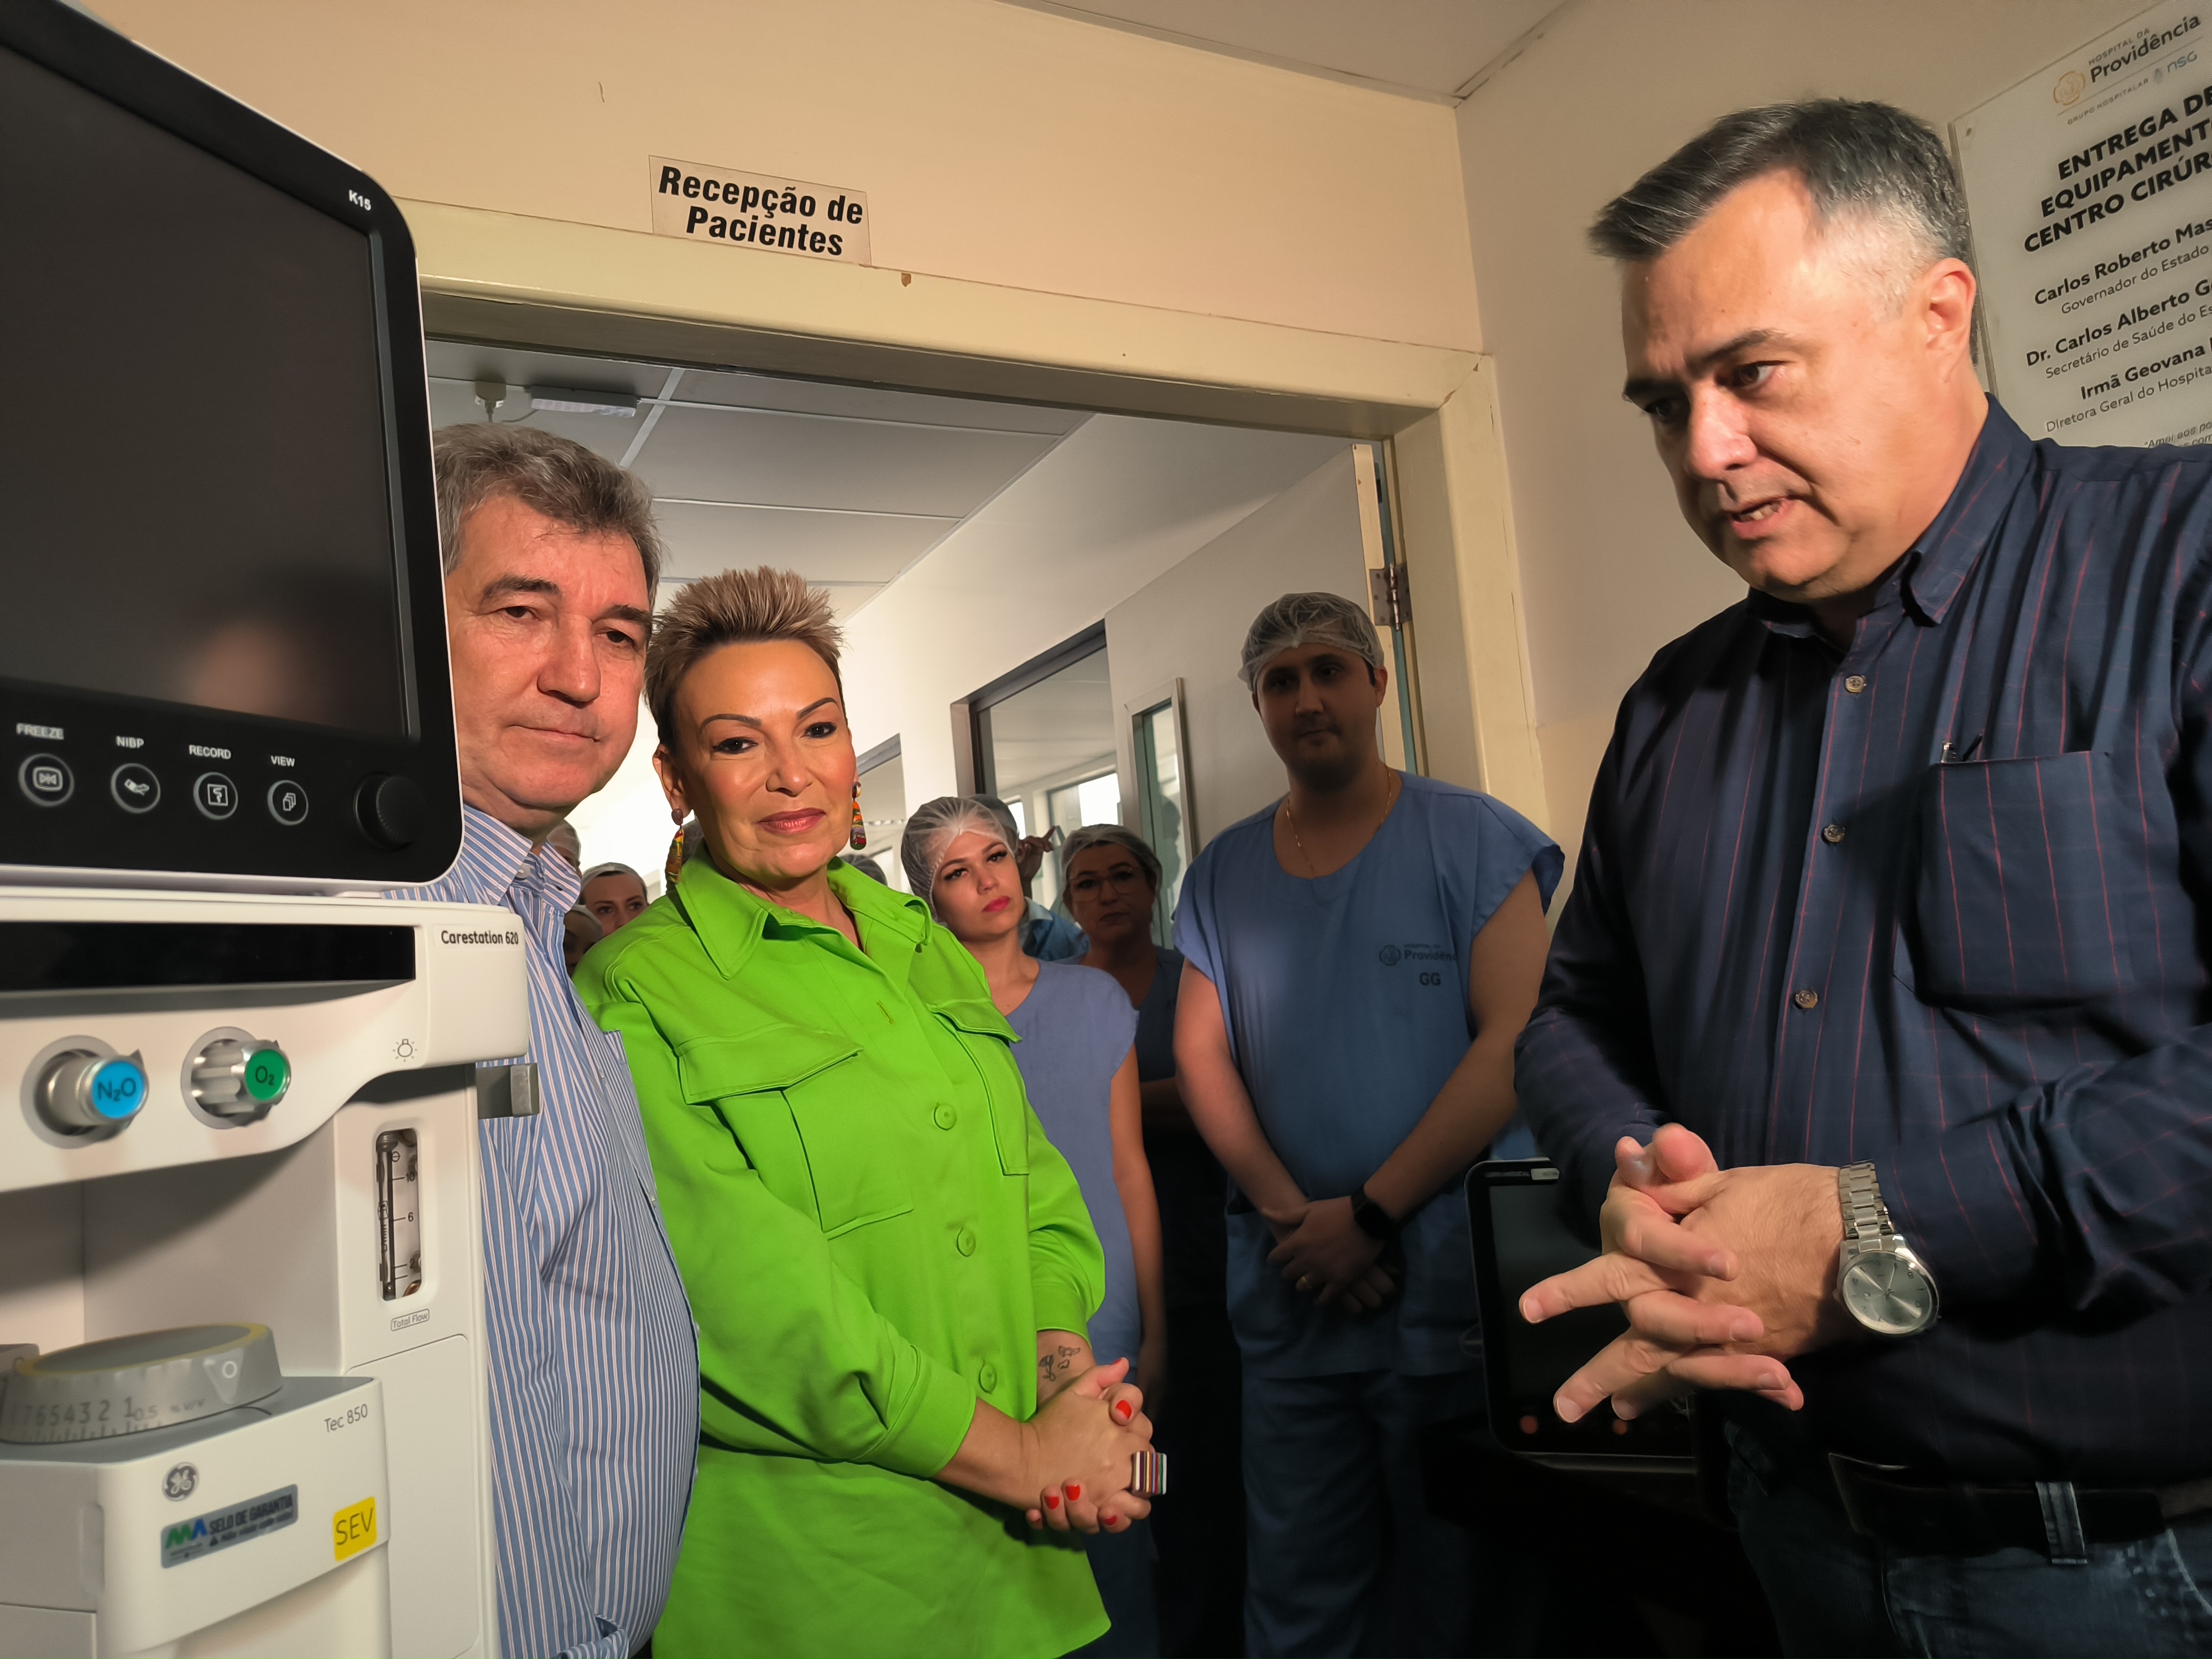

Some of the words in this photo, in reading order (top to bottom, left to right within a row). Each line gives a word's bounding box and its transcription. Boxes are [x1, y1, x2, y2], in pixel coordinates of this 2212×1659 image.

[2089, 38, 2133, 66] HOSPITAL
[2137, 28, 2150, 39] DA
[2090, 15, 2201, 83] Providência
[2067, 106, 2095, 125] GRUPO
[2097, 78, 2149, 109] HOSPITALAR
[2058, 108, 2178, 180] ENTREGA
[2183, 86, 2212, 117] DE
[2041, 118, 2212, 217] EQUIPAMENT
[349, 190, 371, 211] K15
[659, 165, 816, 218] Recepção
[827, 195, 863, 224] de
[2024, 194, 2124, 252] CENTRO
[2131, 152, 2212, 201] CIRÚR
[686, 206, 843, 255] Pacientes
[2035, 273, 2090, 304] Carlos
[2094, 239, 2171, 279] Roberto
[2175, 219, 2212, 244] Mas
[2061, 276, 2137, 314] Governador
[2141, 268, 2158, 280] do
[2161, 245, 2209, 272] Estado
[2026, 350, 2051, 366] Dr.
[2056, 324, 2112, 353] Carlos
[2117, 291, 2190, 330] Alberto
[2195, 279, 2212, 296] G
[2046, 347, 2109, 379] Secretário
[2112, 340, 2129, 352] de
[2132, 321, 2174, 345] Saúde
[2178, 312, 2195, 326] do
[2080, 374, 2121, 400] Irmã
[2125, 345, 2205, 382] Geovana
[2046, 408, 2096, 432] Diretora
[2100, 391, 2134, 412] Geral
[2137, 386, 2154, 399] do
[16, 722, 64, 740] FREEZE
[116, 736, 144, 748] NIBP
[189, 744, 231, 759] RECORD
[270, 755, 295, 767] VIEW
[441, 930, 503, 944] Carestation
[505, 931, 519, 945] 620
[1419, 972, 1441, 985] GG
[405, 1171, 415, 1182] 10
[408, 1212, 414, 1222] 6
[393, 1316, 410, 1329] Total
[412, 1313, 427, 1323] Flow
[324, 1416, 344, 1433] Tec
[347, 1404, 368, 1424] 850
[208, 1515, 234, 1535] SELO
[336, 1507, 373, 1546] SEV
